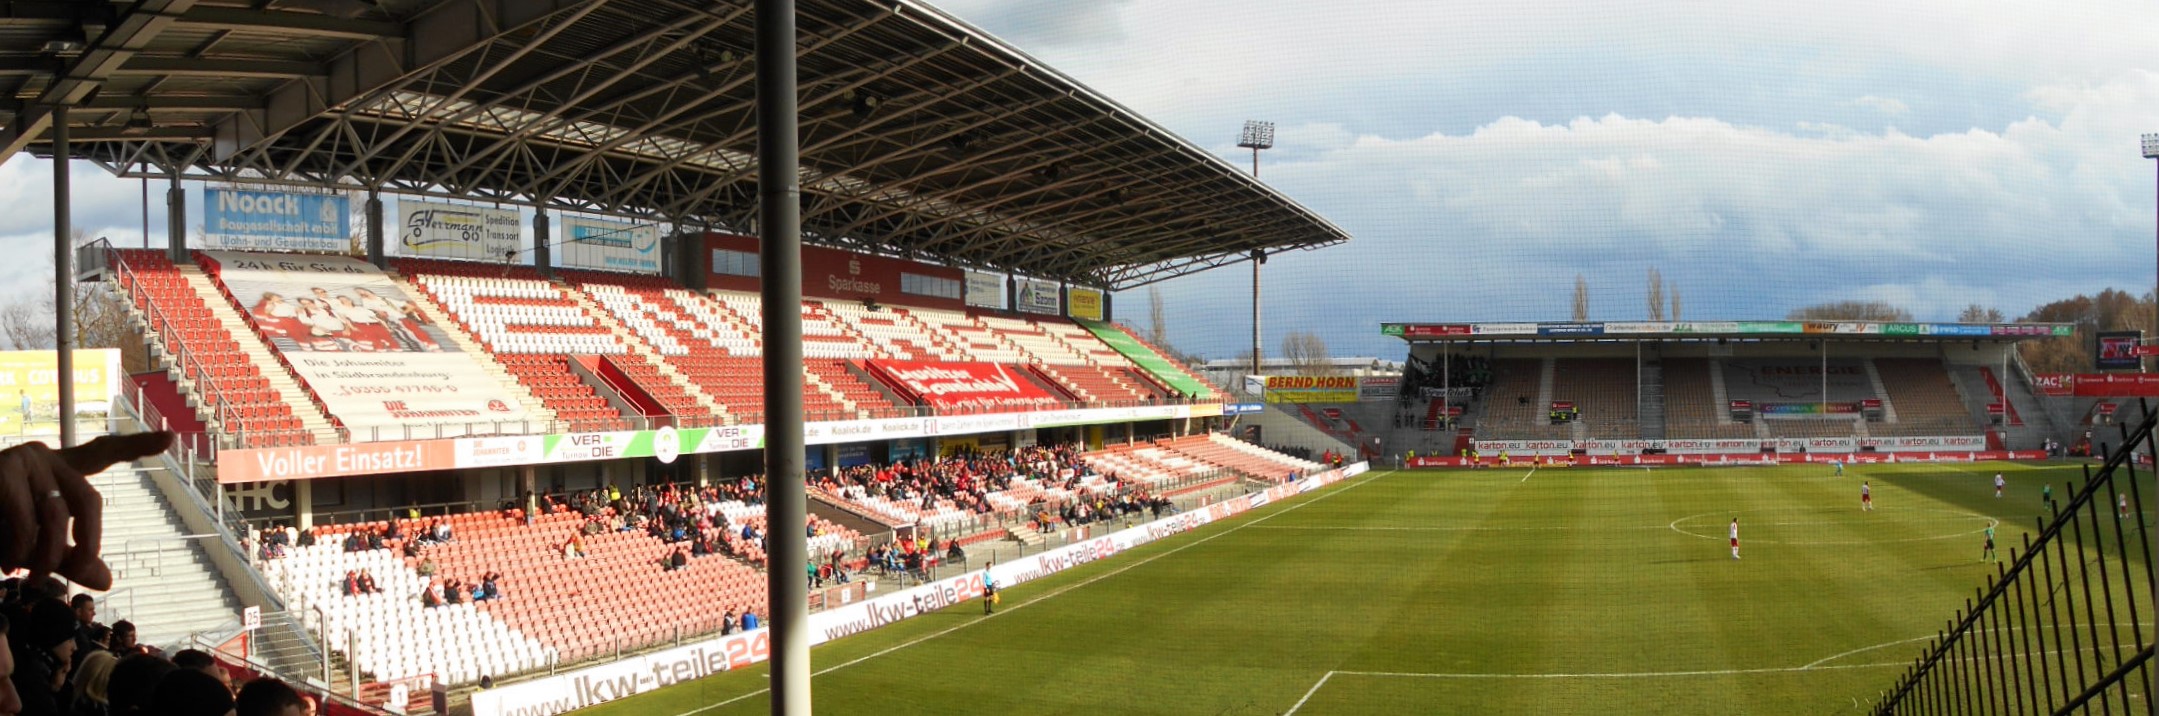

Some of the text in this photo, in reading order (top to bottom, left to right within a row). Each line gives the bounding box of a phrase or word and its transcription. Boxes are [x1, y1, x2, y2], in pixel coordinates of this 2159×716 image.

[218, 190, 298, 215] Noack
[485, 214, 519, 226] Spedition
[255, 237, 272, 247] und
[828, 275, 880, 294] Sparkasse
[1268, 376, 1314, 389] BERND
[716, 428, 740, 438] VER
[571, 434, 601, 446] VER
[731, 438, 749, 449] DIE
[1479, 440, 1520, 449] karton.eu
[1526, 440, 1568, 449] karton.eu
[1573, 440, 1615, 449] karton.eu
[1621, 439, 1664, 449] karton.eu
[1716, 438, 1757, 448] karton.eu
[1809, 438, 1850, 447] karton.eu
[1855, 437, 1895, 446] karton.eu
[1900, 437, 1940, 446] karton.eu
[1943, 437, 1983, 446] karton.eu
[592, 446, 613, 458] DIE
[257, 444, 423, 477] Voller Einsatz!
[1014, 537, 1126, 584] www.lkw-teile24.de
[247, 611, 259, 625] 25
